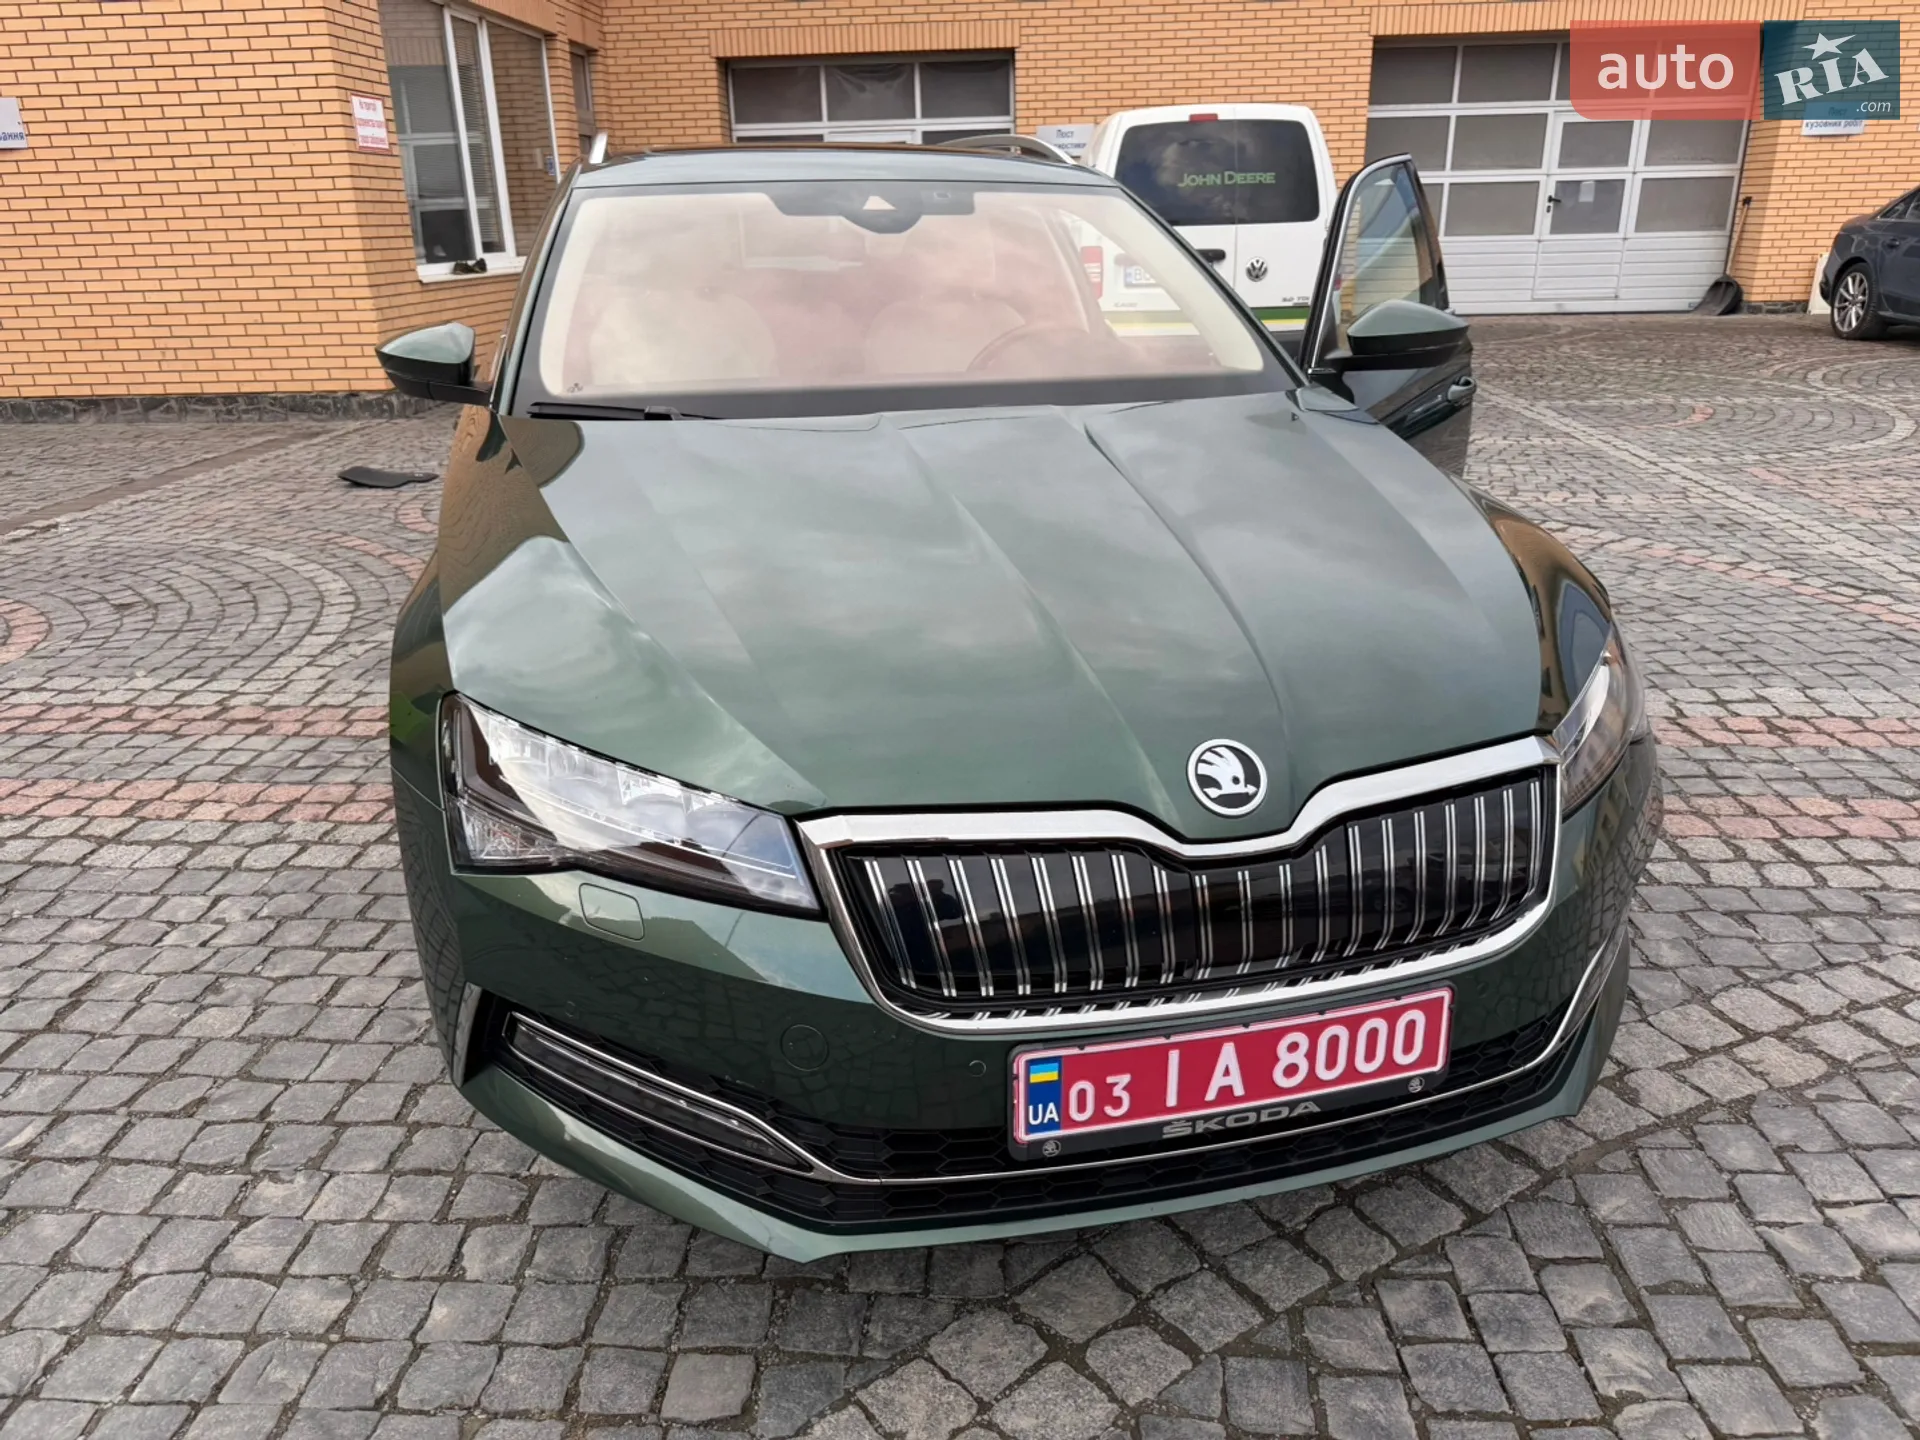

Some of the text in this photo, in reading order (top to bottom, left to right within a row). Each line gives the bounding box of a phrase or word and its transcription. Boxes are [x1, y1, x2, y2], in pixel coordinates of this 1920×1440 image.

[1068, 1074, 1132, 1122] 03
[1272, 1008, 1427, 1089] 8000
[1028, 1103, 1060, 1126] UA
[1161, 1100, 1323, 1140] ŠKODA
